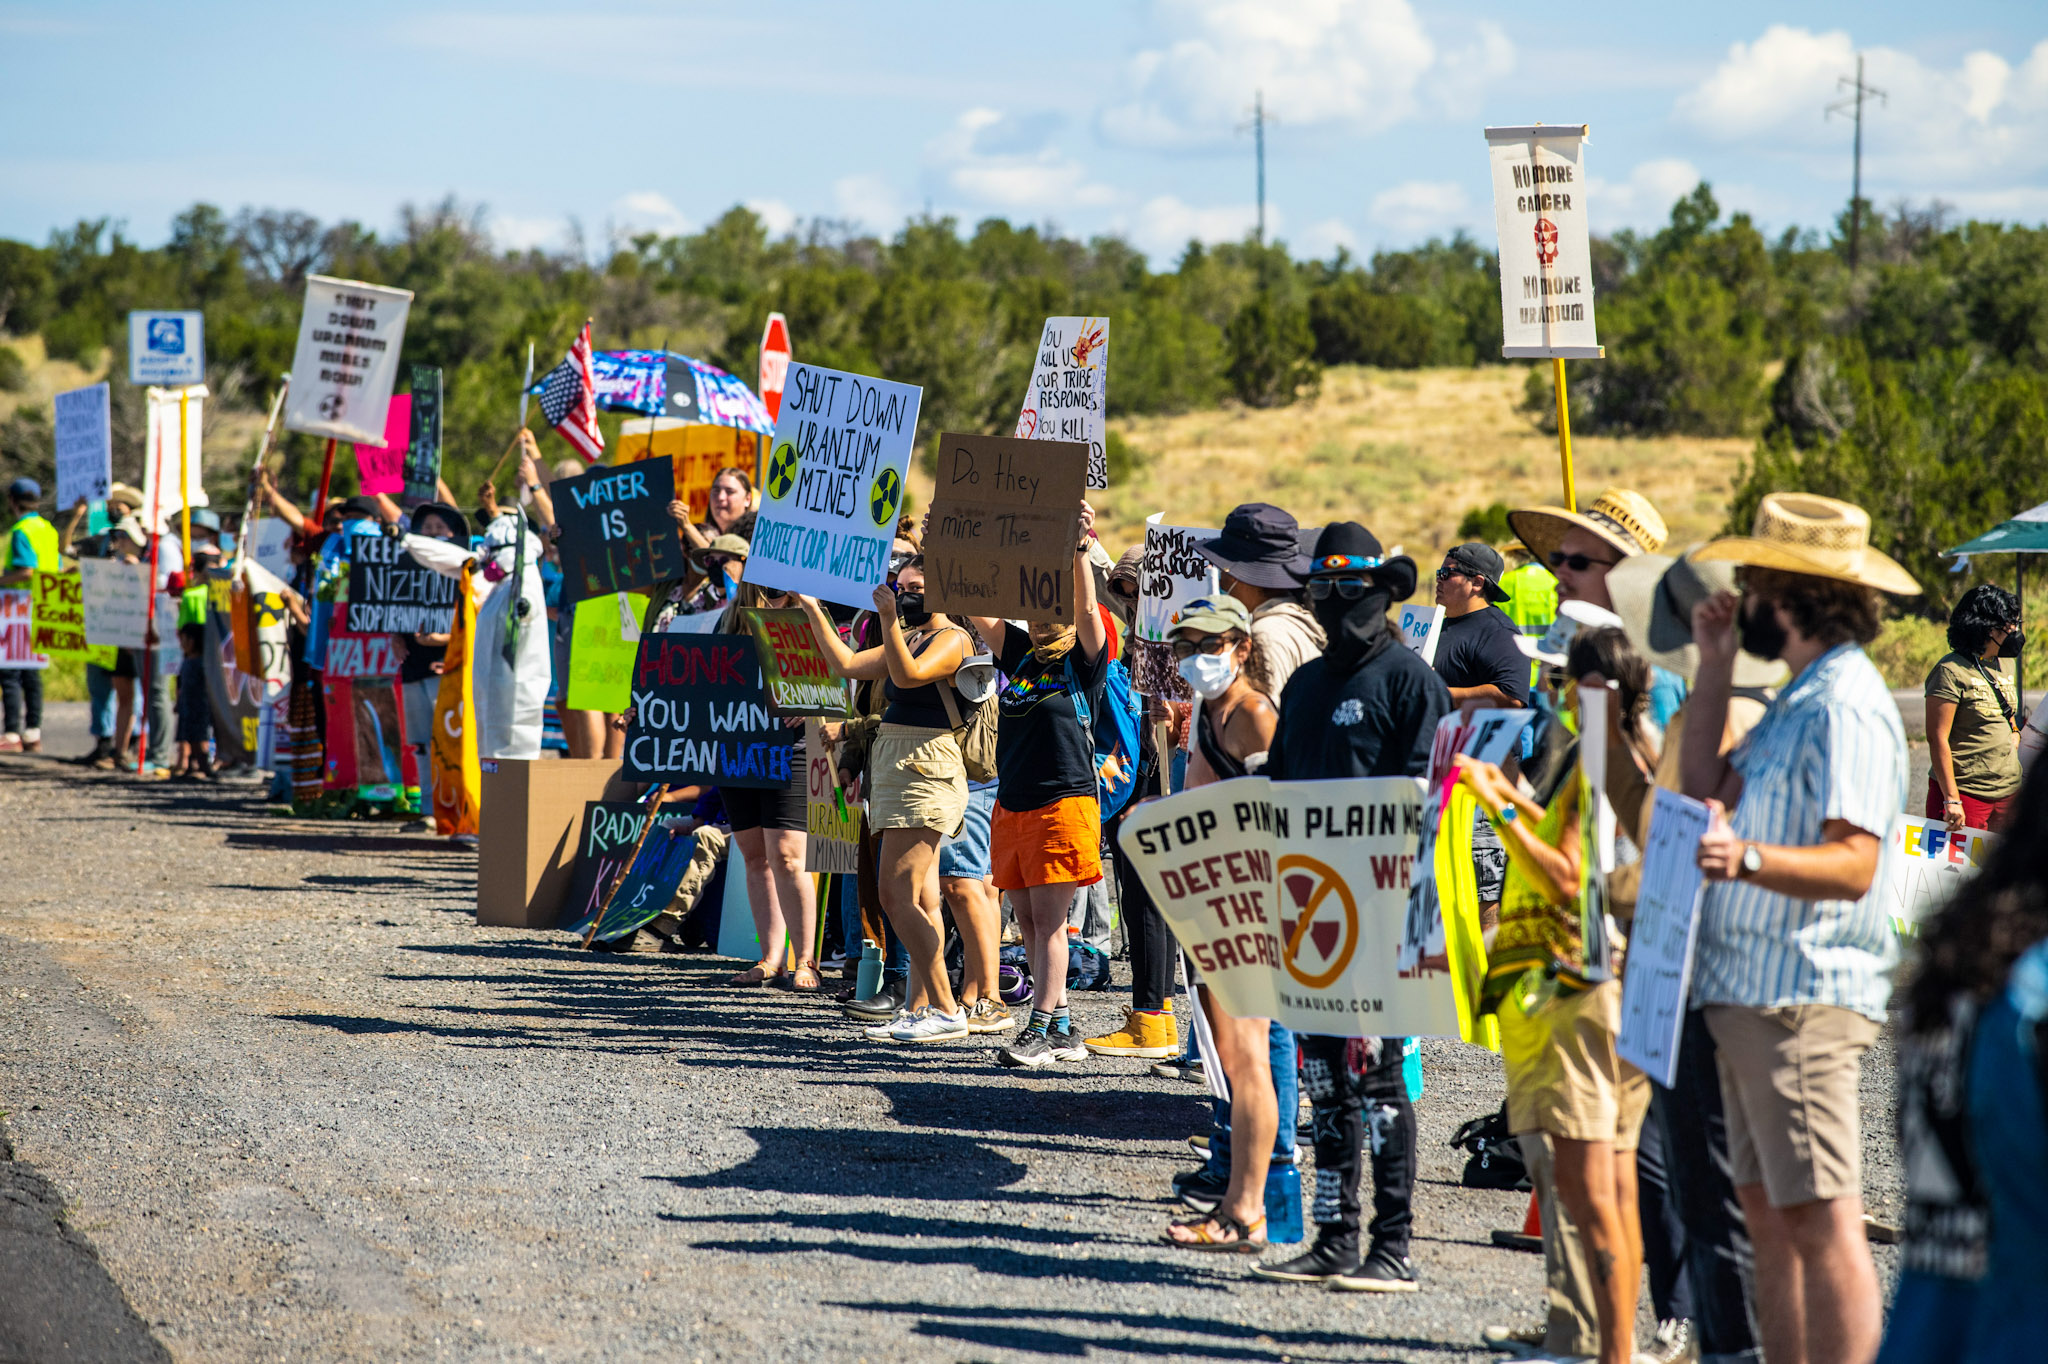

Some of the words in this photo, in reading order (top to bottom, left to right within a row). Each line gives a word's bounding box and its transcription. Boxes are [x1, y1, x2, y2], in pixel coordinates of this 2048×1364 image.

[1532, 164, 1573, 184] MORE
[1517, 193, 1572, 213] CANCER
[1540, 275, 1581, 295] MORE
[1519, 303, 1584, 324] URANIUM
[1044, 324, 1062, 348] YOU
[1041, 350, 1057, 368] KILL
[1037, 371, 1059, 390] OUR
[1063, 368, 1092, 389] TRIBE
[790, 367, 843, 418] SHUT
[847, 378, 907, 435] DOWN
[1039, 415, 1055, 435] YOU
[1061, 417, 1088, 442] KILL
[796, 419, 881, 479] URANIUM
[571, 471, 649, 509] WATER
[795, 467, 860, 519] MINES
[952, 448, 980, 485] Do
[994, 453, 1040, 505] they
[601, 509, 627, 540] IS
[941, 514, 982, 539] mine
[995, 512, 1031, 547] The
[580, 531, 672, 595] LIFE
[752, 516, 806, 566] PROTECT
[801, 528, 829, 572] OUR
[829, 533, 888, 585] WATER!
[1020, 564, 1063, 616] NO!
[1402, 612, 1432, 638] PRO
[640, 639, 746, 688] HONK
[776, 652, 830, 679] DOWN
[632, 690, 690, 732] YOU
[630, 736, 718, 775] CLEAN
[720, 742, 793, 781] WATER
[1136, 810, 1217, 854] STOP
[1305, 804, 1396, 838] PLAIN
[1159, 849, 1273, 900] DEFEND
[1206, 891, 1268, 928] THE
